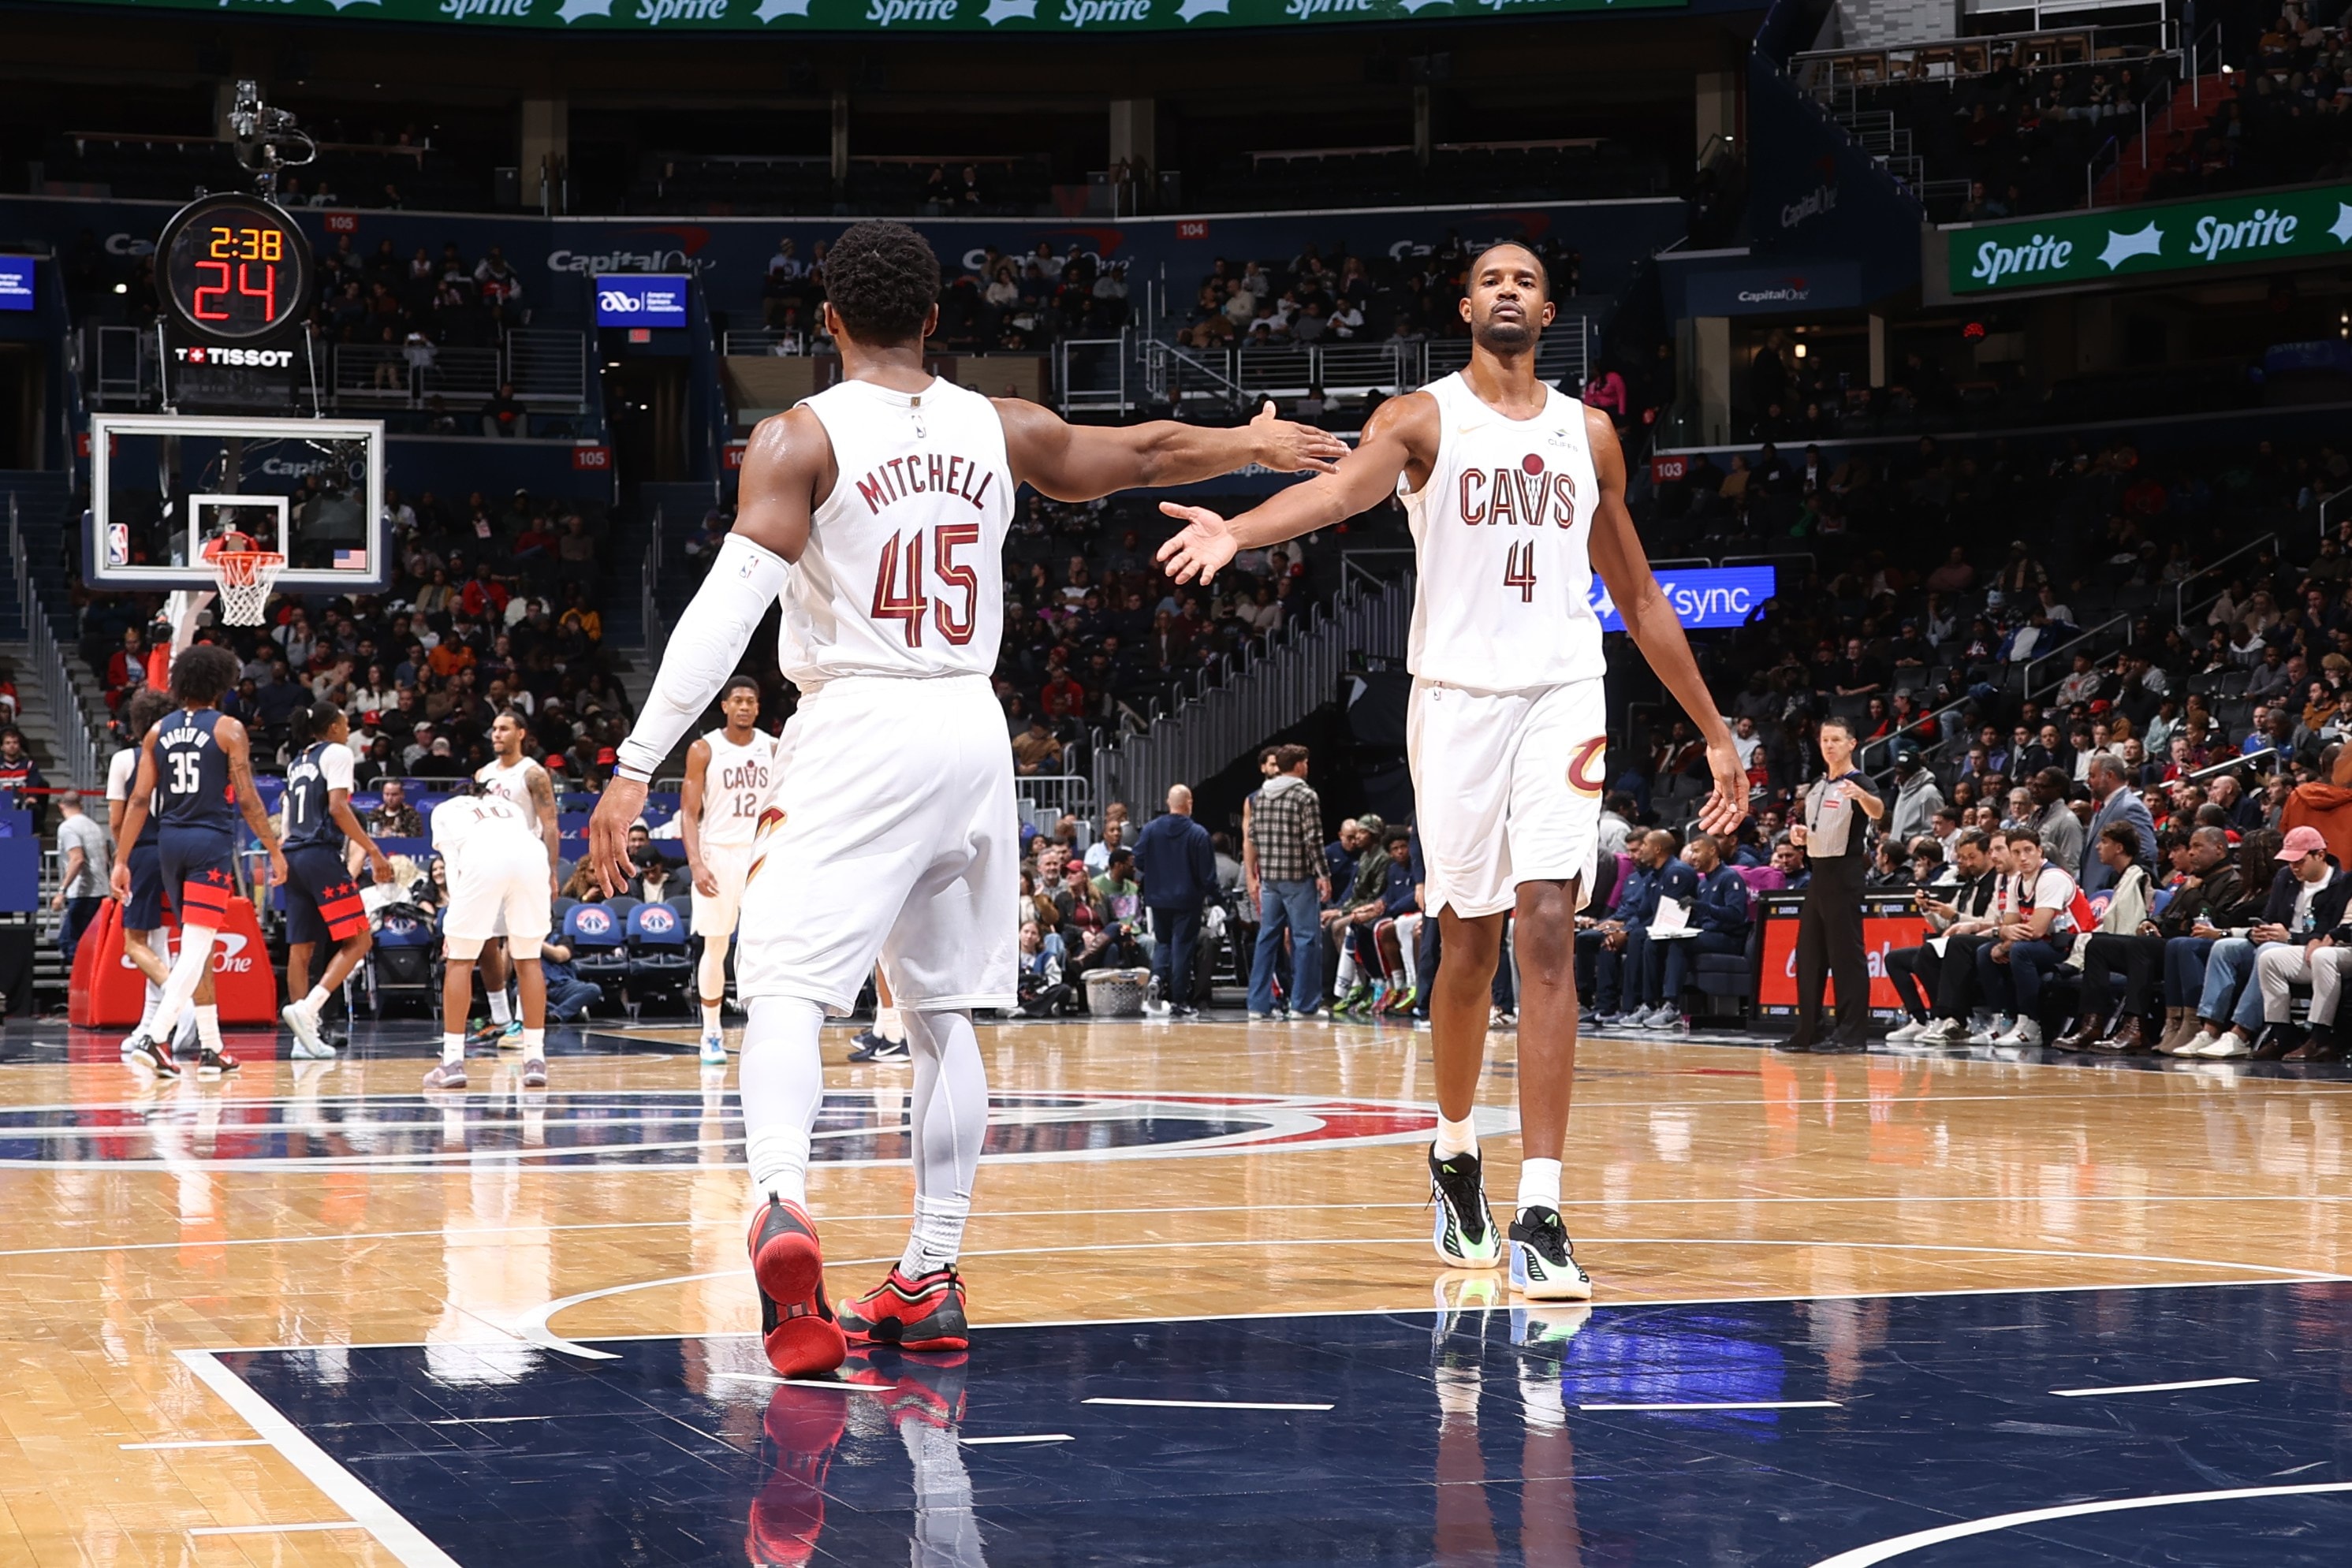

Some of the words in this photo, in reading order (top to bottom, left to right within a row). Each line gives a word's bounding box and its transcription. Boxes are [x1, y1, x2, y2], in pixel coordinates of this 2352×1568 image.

[329, 216, 353, 229] 105
[1180, 223, 1204, 236] 104
[211, 227, 281, 260] 2:38
[1971, 234, 2073, 285] Sprite
[2189, 208, 2298, 261] Sprite
[194, 260, 274, 322] 24
[207, 348, 293, 367] TISSOT
[578, 452, 606, 466] 105
[729, 451, 744, 466] 10
[1657, 462, 1683, 478] 103
[855, 453, 993, 515] MITCHELL
[1459, 468, 1575, 529] CAVS
[1504, 538, 1537, 603] 4
[870, 523, 979, 648] 45
[168, 751, 200, 795] 35
[723, 765, 768, 790] CAVS
[732, 793, 757, 818] 12
